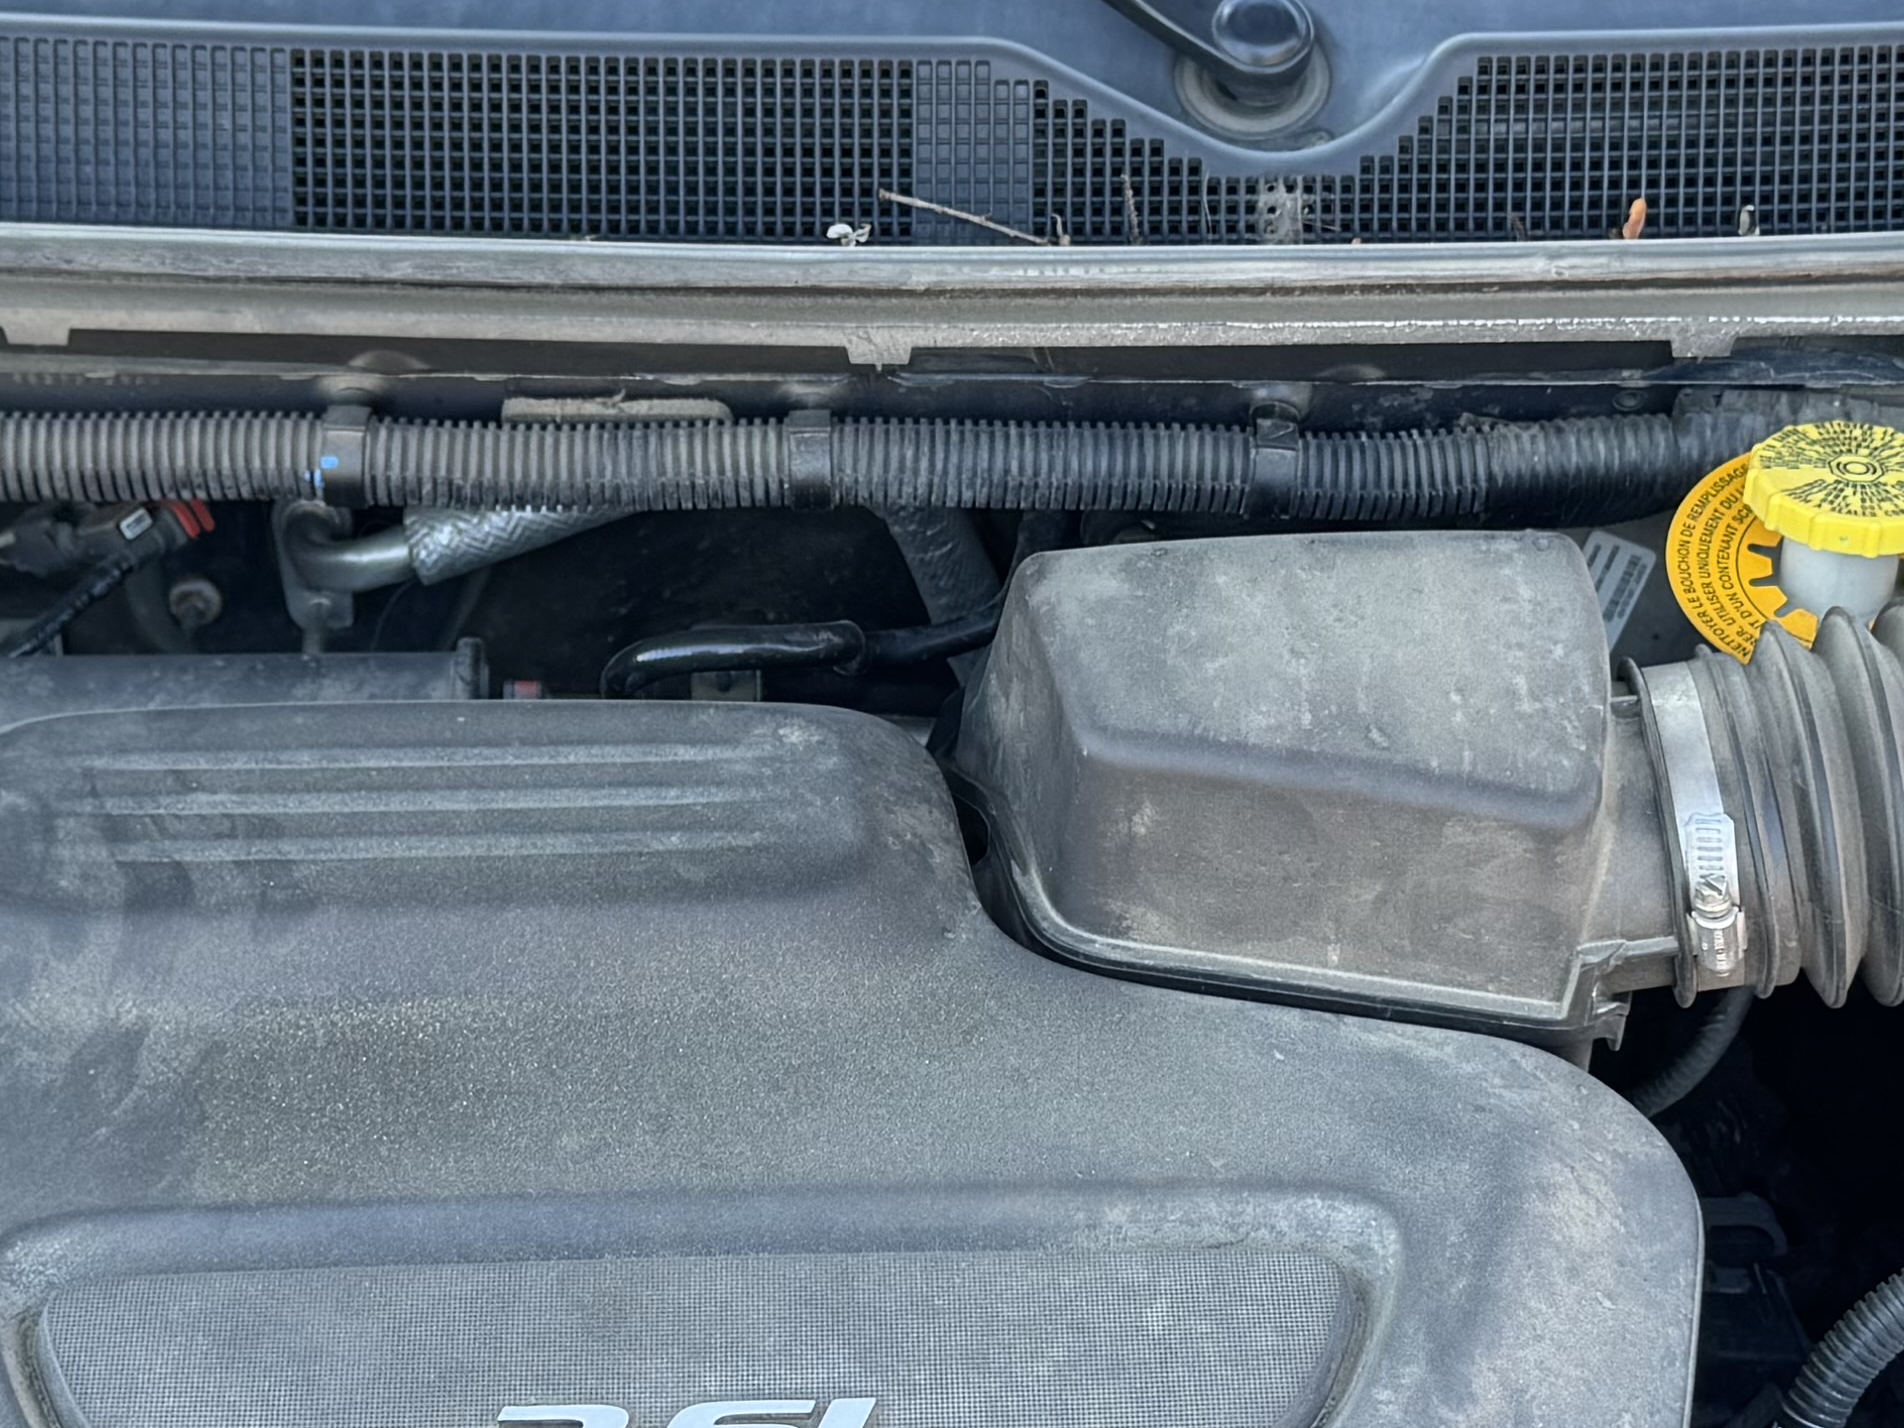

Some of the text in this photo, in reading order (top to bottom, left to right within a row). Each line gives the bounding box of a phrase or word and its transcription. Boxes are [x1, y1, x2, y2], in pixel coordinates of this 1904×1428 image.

[1680, 524, 1696, 538] DE
[1677, 541, 1696, 595] BOUCHON
[1697, 492, 1738, 628] UTILISER UNIQUEMENT DU
[1717, 523, 1738, 590] CONTENANT
[1687, 596, 1703, 609] LE
[1697, 611, 1750, 657] NETTOYER
